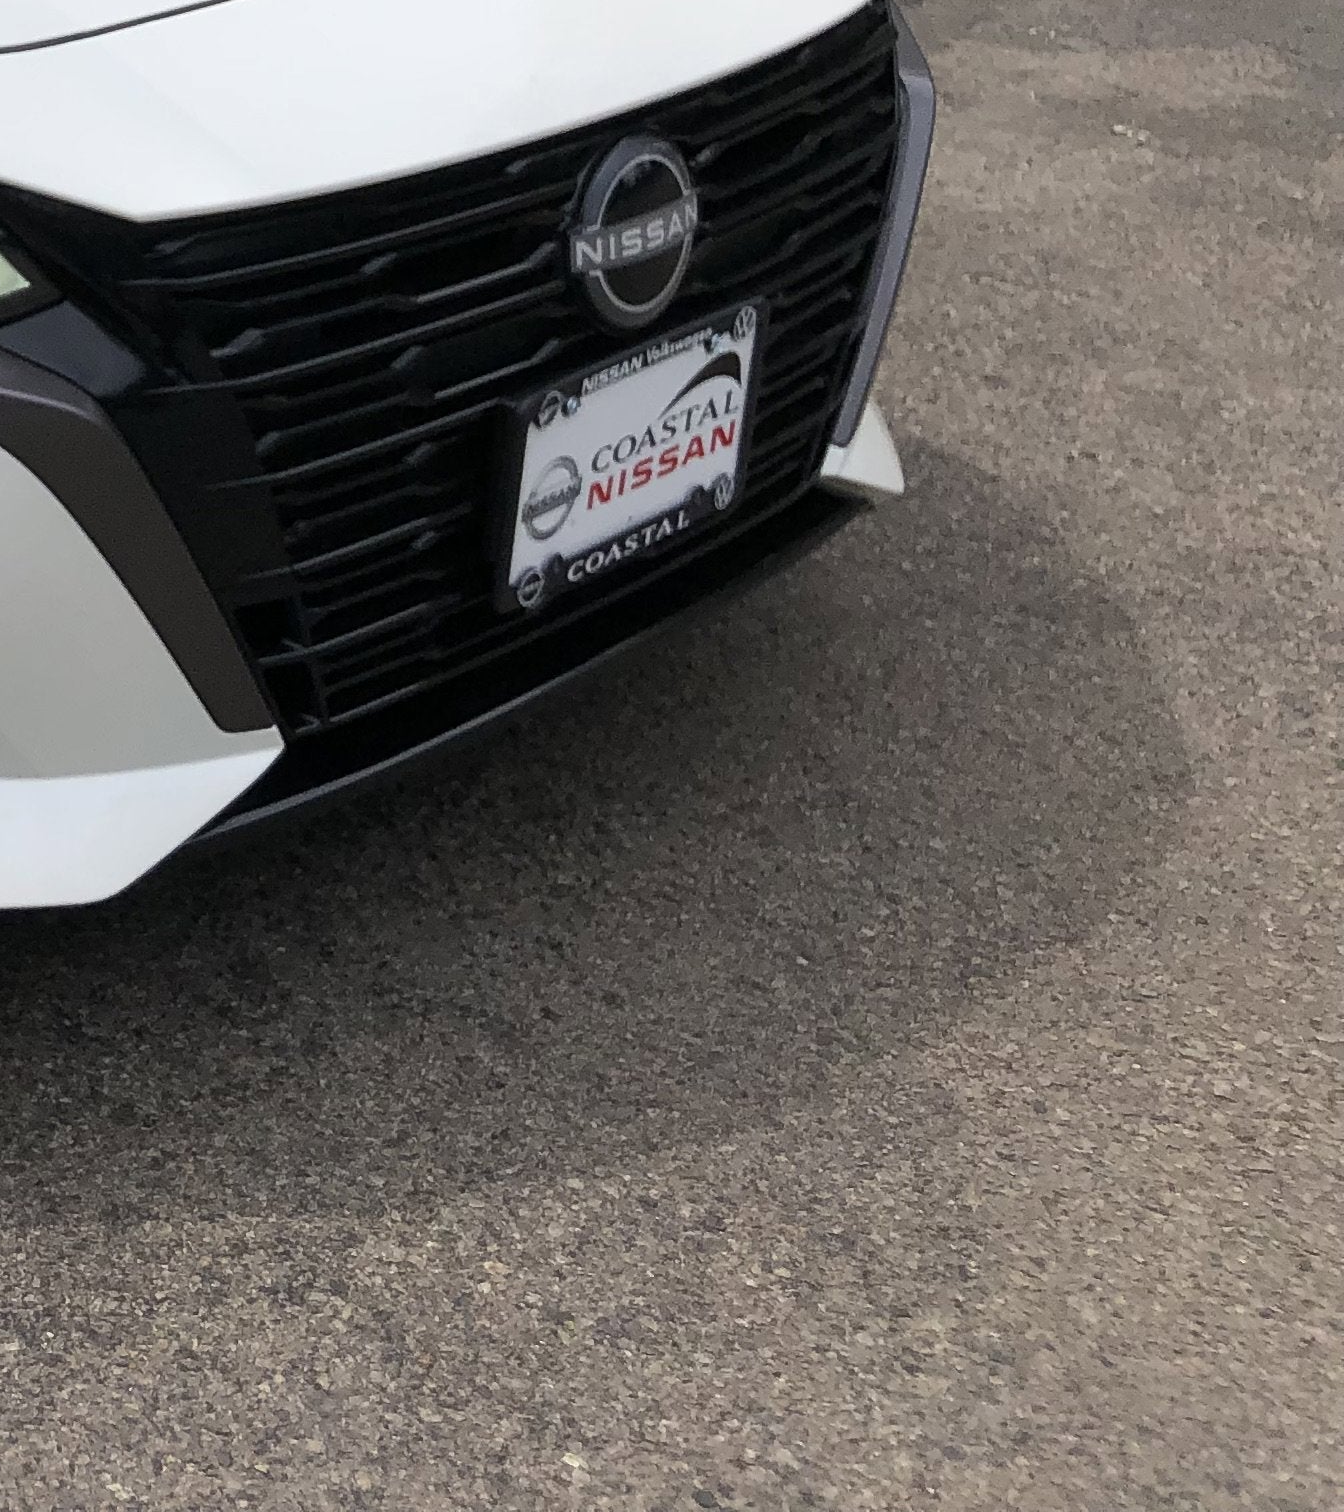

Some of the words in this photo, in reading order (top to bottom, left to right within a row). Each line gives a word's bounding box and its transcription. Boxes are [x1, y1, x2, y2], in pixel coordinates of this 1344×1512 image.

[575, 196, 698, 270] NISSAN
[586, 419, 736, 511] NISSAN
[591, 389, 740, 473] COASTAL
[567, 510, 690, 582] COASTAL
